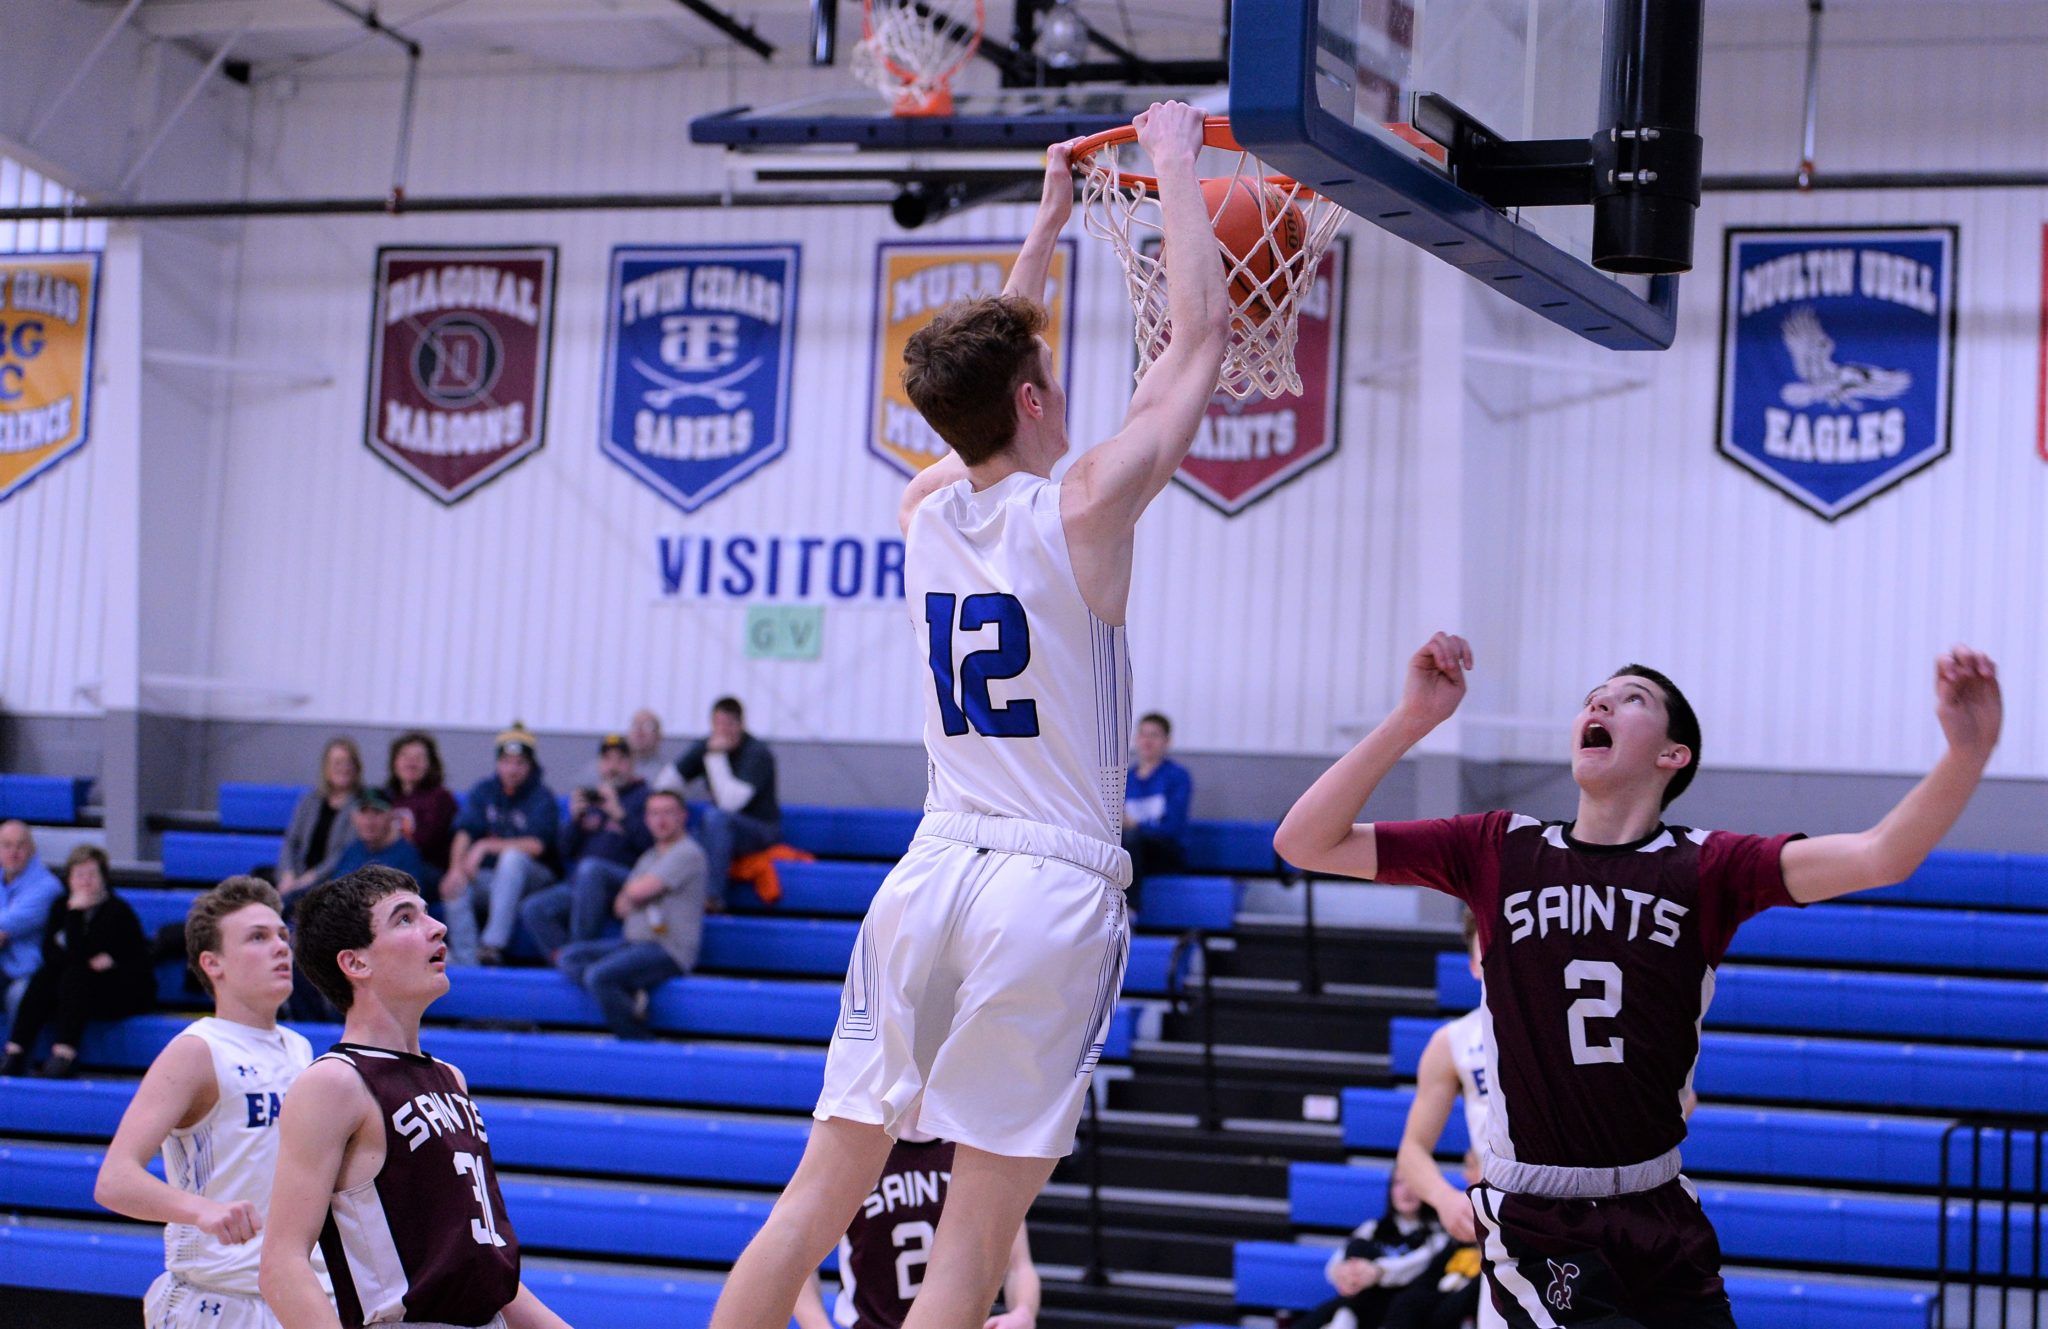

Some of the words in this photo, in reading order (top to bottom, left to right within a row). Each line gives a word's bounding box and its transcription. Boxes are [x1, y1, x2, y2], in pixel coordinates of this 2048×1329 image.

[388, 266, 537, 325] DIAGONAL
[623, 267, 689, 325] TWIN
[692, 265, 781, 325] CEDARS
[1742, 249, 1855, 315] MOULTON
[1859, 250, 1936, 316] UDELL
[385, 400, 525, 456] MAROONS
[634, 409, 755, 461] SABERS
[1189, 409, 1297, 460] AINTS
[1764, 407, 1905, 463] EAGLES
[658, 537, 906, 599] VISITOR
[926, 592, 1040, 738] 12
[1503, 885, 1690, 948] SAINTS
[1564, 959, 1624, 1065] 2
[392, 1092, 488, 1152] SAINTS
[453, 1152, 506, 1247] 31
[862, 1170, 951, 1219] SAIN
